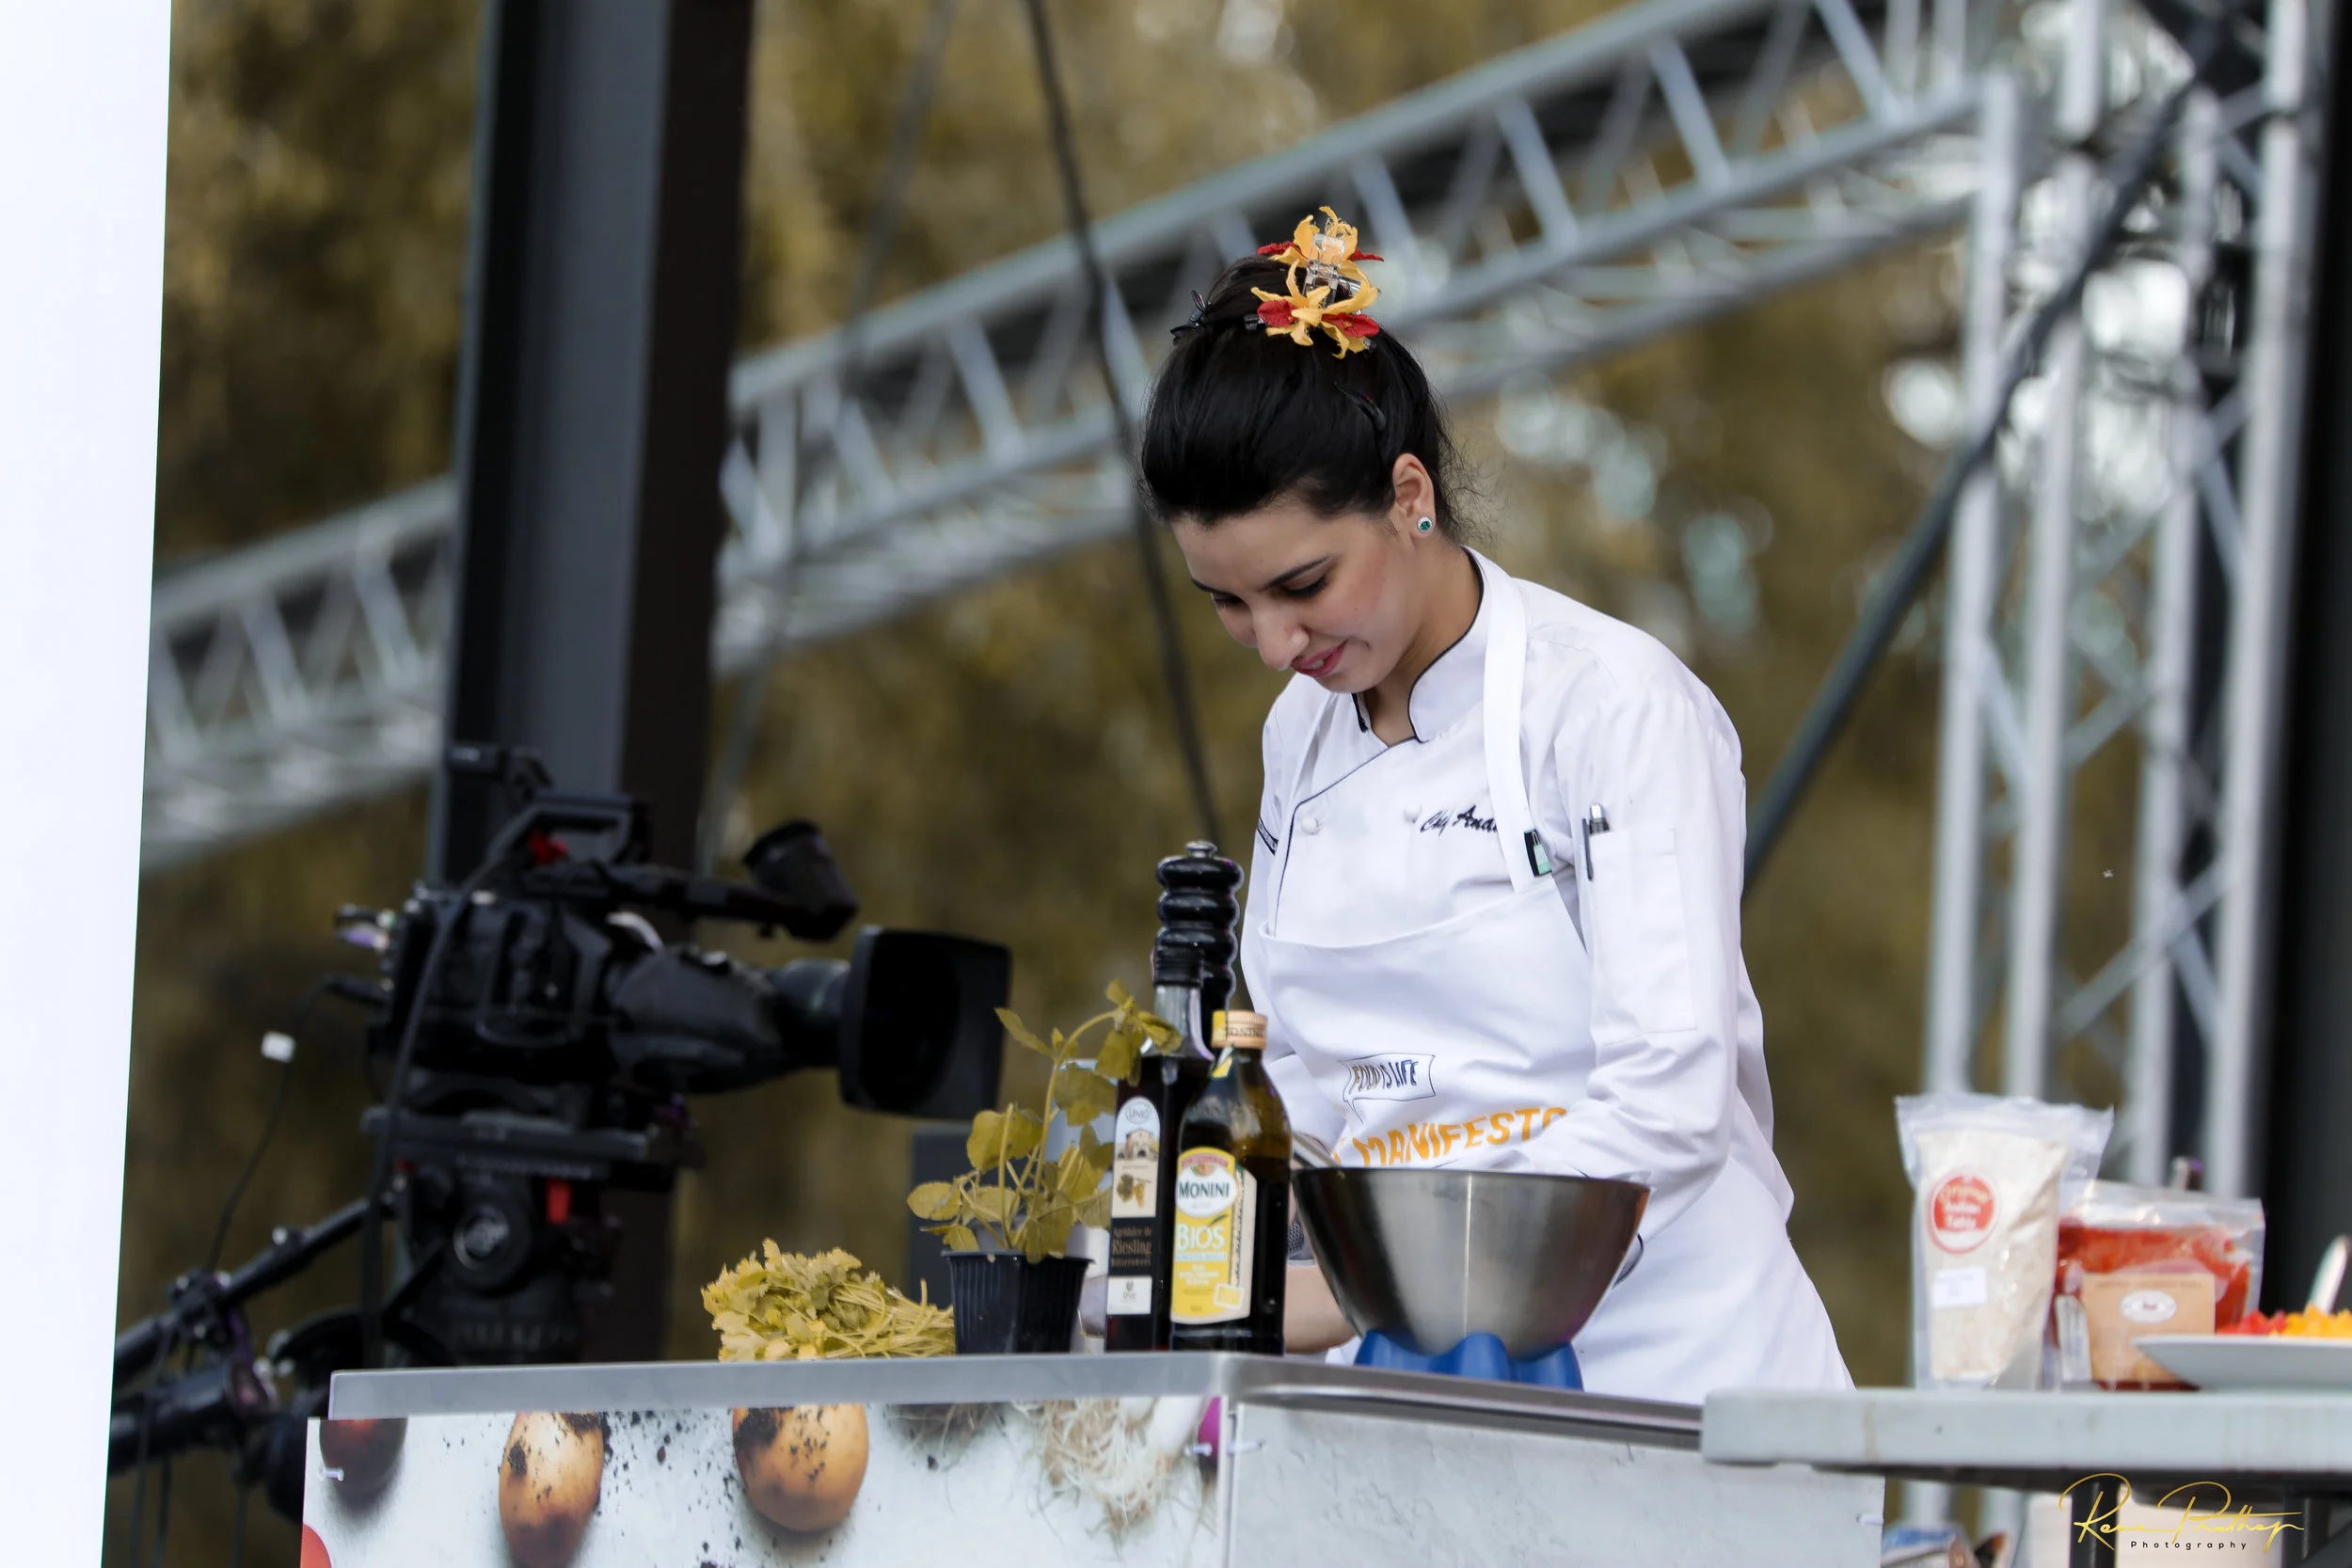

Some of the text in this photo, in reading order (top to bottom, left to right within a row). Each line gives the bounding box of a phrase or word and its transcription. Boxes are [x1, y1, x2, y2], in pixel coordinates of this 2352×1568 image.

[1388, 1059, 1420, 1088] LIFE
[1179, 1180, 1231, 1199] MONINI
[1112, 1239, 1152, 1256] Riesling
